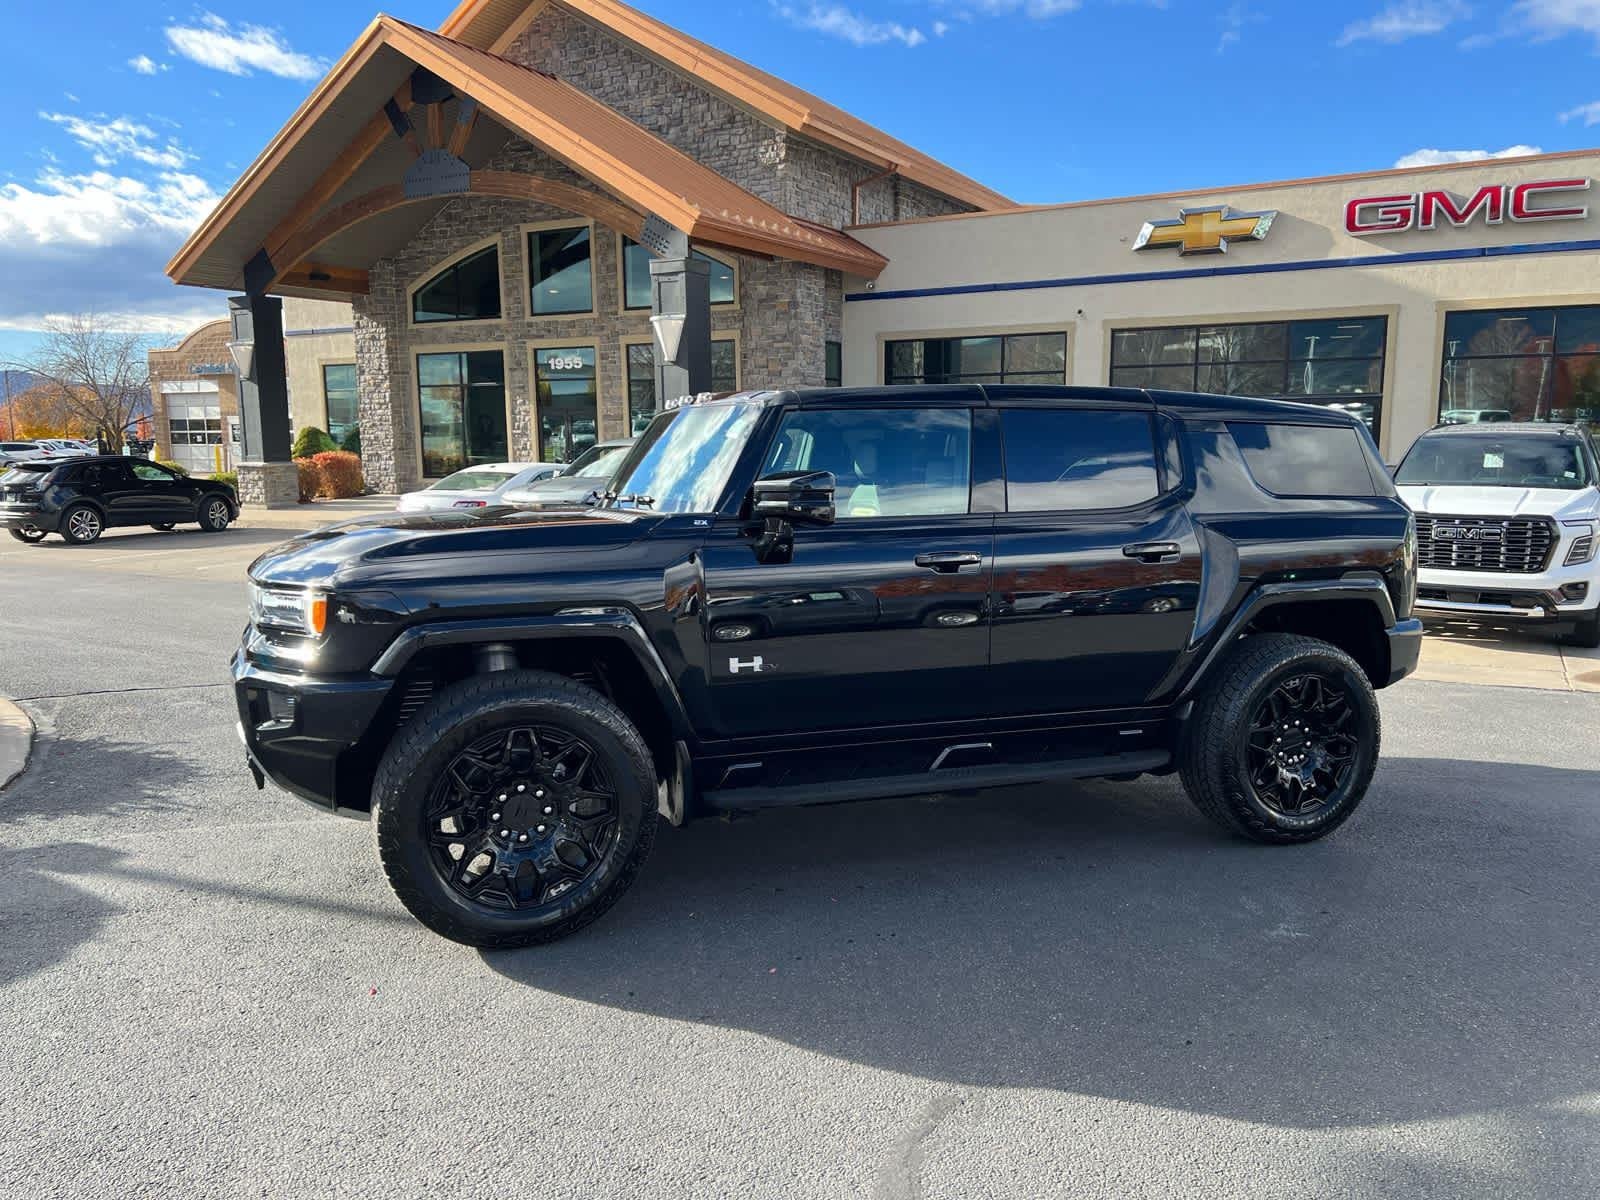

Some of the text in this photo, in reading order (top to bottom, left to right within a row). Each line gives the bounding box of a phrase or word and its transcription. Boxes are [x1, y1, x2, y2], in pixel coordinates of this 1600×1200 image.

[1345, 177, 1591, 235] GMC
[548, 357, 583, 370] 1955
[1436, 527, 1501, 540] GMC
